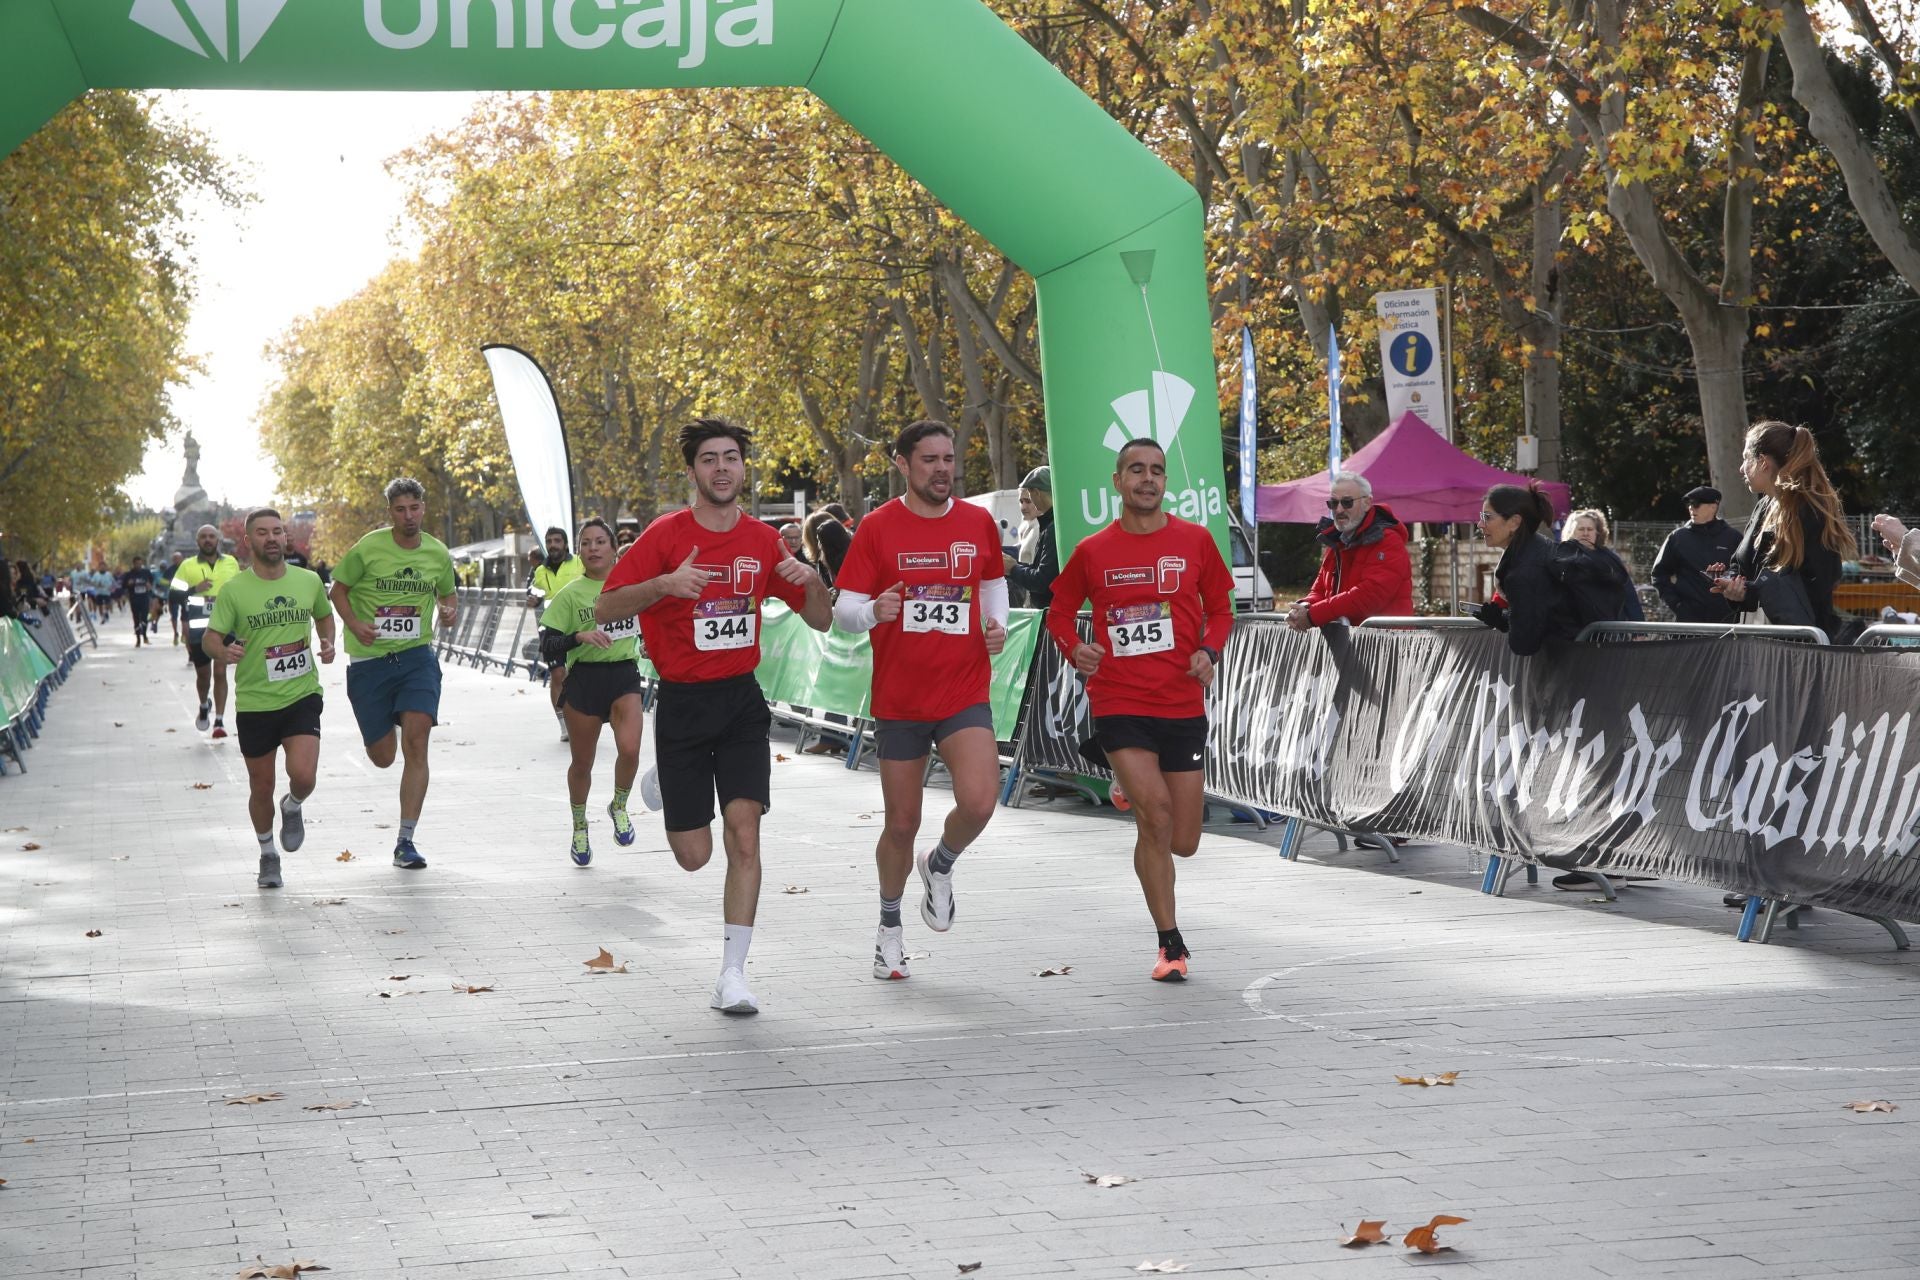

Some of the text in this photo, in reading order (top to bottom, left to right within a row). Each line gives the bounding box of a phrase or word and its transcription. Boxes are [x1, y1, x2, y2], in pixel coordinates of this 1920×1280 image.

[363, 0, 773, 69] Unicaja
[1384, 298, 1420, 309] Oficina de
[1081, 478, 1222, 526] Ucaja
[707, 569, 723, 577] inera
[740, 562, 757, 570] Findus
[246, 608, 312, 629] ENTREPINARE
[913, 602, 959, 624] 343
[381, 618, 414, 632] 450
[603, 617, 634, 633] 448
[704, 617, 748, 640] 344
[1116, 622, 1163, 647] 345
[274, 653, 306, 672] 449
[1453, 669, 1605, 825] Norte
[1607, 702, 1682, 828] de
